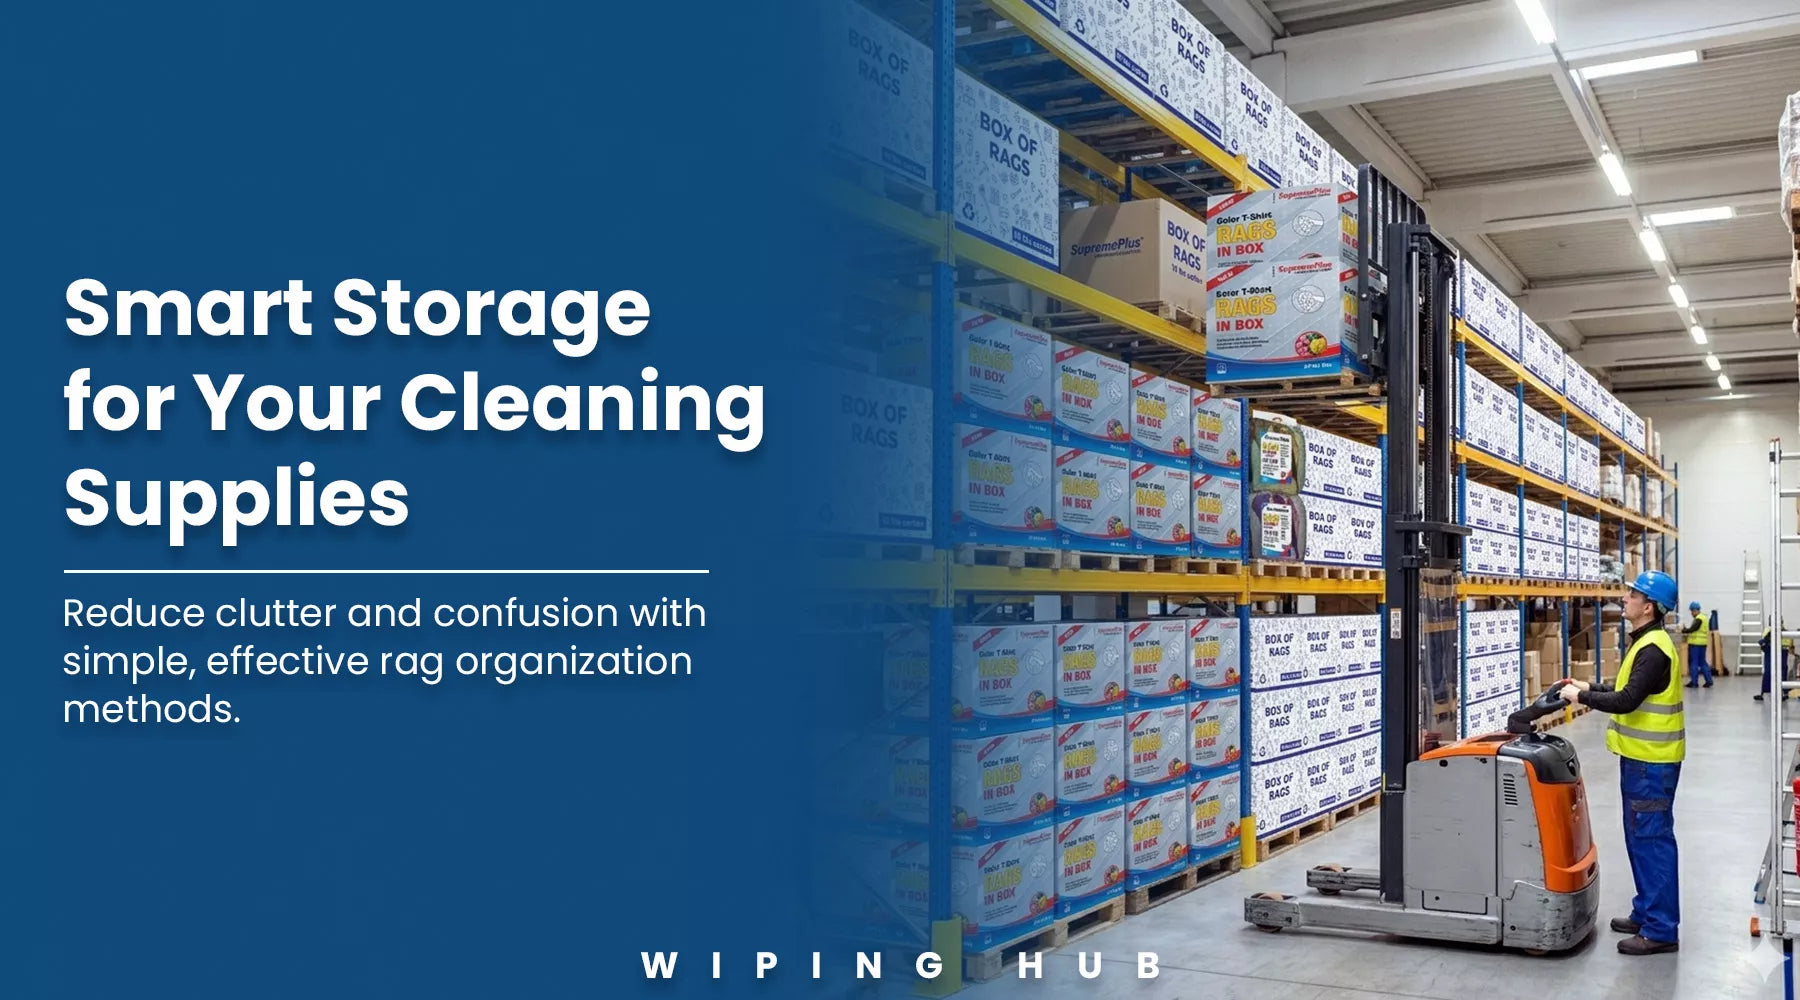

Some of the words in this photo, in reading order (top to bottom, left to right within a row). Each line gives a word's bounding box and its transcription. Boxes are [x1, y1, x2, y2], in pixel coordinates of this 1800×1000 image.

[1171, 17, 1194, 47] BOX
[848, 27, 883, 64] BOX
[888, 52, 910, 75] OF
[1177, 41, 1206, 74] RAGS
[858, 58, 901, 97] RAGS
[980, 110, 1013, 145] BOX
[1017, 133, 1038, 156] OF
[989, 141, 1030, 177] RAGS
[1167, 220, 1190, 246] BOX
[1192, 234, 1206, 252] OF
[1216, 219, 1277, 245] RAGS
[1070, 237, 1141, 257] SupremePlus
[1217, 246, 1231, 257] IN
[1235, 242, 1265, 255] BOX
[1173, 244, 1201, 271] RAGS
[1215, 294, 1277, 318] RAGS
[1216, 321, 1230, 332] IN
[1235, 318, 1264, 330] BOX
[969, 366, 980, 379] IN
[984, 370, 1005, 385] BOX
[840, 393, 879, 421] BOX
[884, 404, 907, 425] OF
[850, 423, 898, 449] RAGS
[1313, 455, 1334, 469] RAGS
[968, 482, 980, 495] IN
[984, 484, 1005, 498] BOX
[1313, 523, 1334, 535] RAGS
[1284, 633, 1294, 643] OF
[979, 679, 990, 691] IN
[993, 678, 1012, 690] BOX
[1063, 671, 1073, 682] IN
[1075, 670, 1091, 681] BOX
[1283, 772, 1294, 784] OF
[996, 784, 1015, 798] BOX
[984, 893, 994, 906] IN
[996, 886, 1016, 901] BOX
